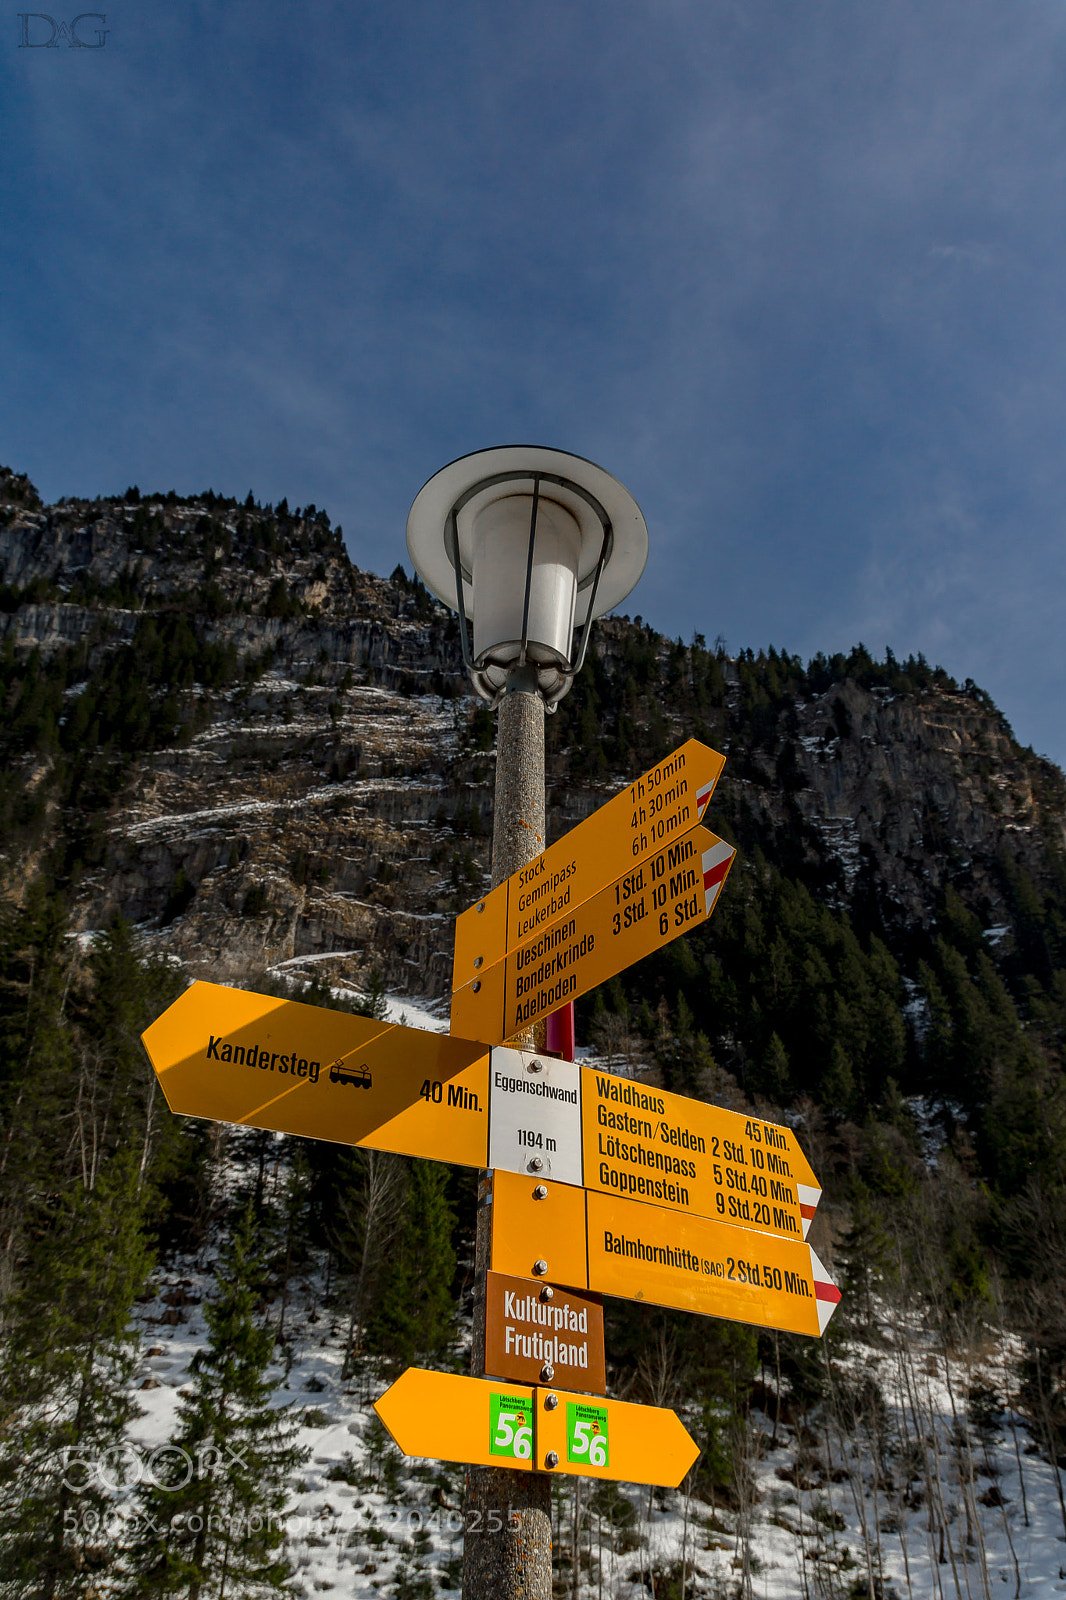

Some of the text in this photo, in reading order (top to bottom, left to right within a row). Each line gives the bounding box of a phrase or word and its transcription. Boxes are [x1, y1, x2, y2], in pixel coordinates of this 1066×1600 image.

[518, 860, 577, 912] Gemmipass
[519, 856, 546, 889] Stock
[615, 840, 698, 905] 1 Std. 10 Min.
[518, 885, 570, 938] Leukerbad
[612, 869, 700, 936] 3 Std. 10 Min.
[659, 893, 702, 936] 6 Std.
[516, 919, 576, 971] Ueschinen
[516, 934, 595, 998] Bonderkrinde
[515, 973, 577, 1027] Adelboden
[206, 1035, 321, 1083] Kandersteg
[419, 1079, 483, 1112] 40 Min.
[494, 1071, 578, 1105] Eggenschwand
[595, 1076, 665, 1115] Waldhaus
[517, 1129, 557, 1152] 1194 m
[597, 1104, 706, 1154] Gastern/Selden
[745, 1120, 790, 1152] 45 Min.
[598, 1132, 697, 1179] Lötschenpass
[711, 1136, 793, 1178] 2 Std. 10 Min.
[599, 1162, 689, 1206] Goppenstein
[713, 1164, 723, 1186] 5
[770, 1179, 797, 1206] Min.
[716, 1192, 725, 1214] 9
[773, 1206, 800, 1234] Min.
[604, 1231, 699, 1273] Balmhornhütte
[701, 1258, 725, 1279] (SAC)
[726, 1257, 736, 1281] 2
[785, 1270, 813, 1298] Min.
[504, 1290, 588, 1334] Kulturpfad
[505, 1325, 588, 1369] Frutigland
[494, 1412, 533, 1459] 56
[572, 1420, 607, 1467] 56
